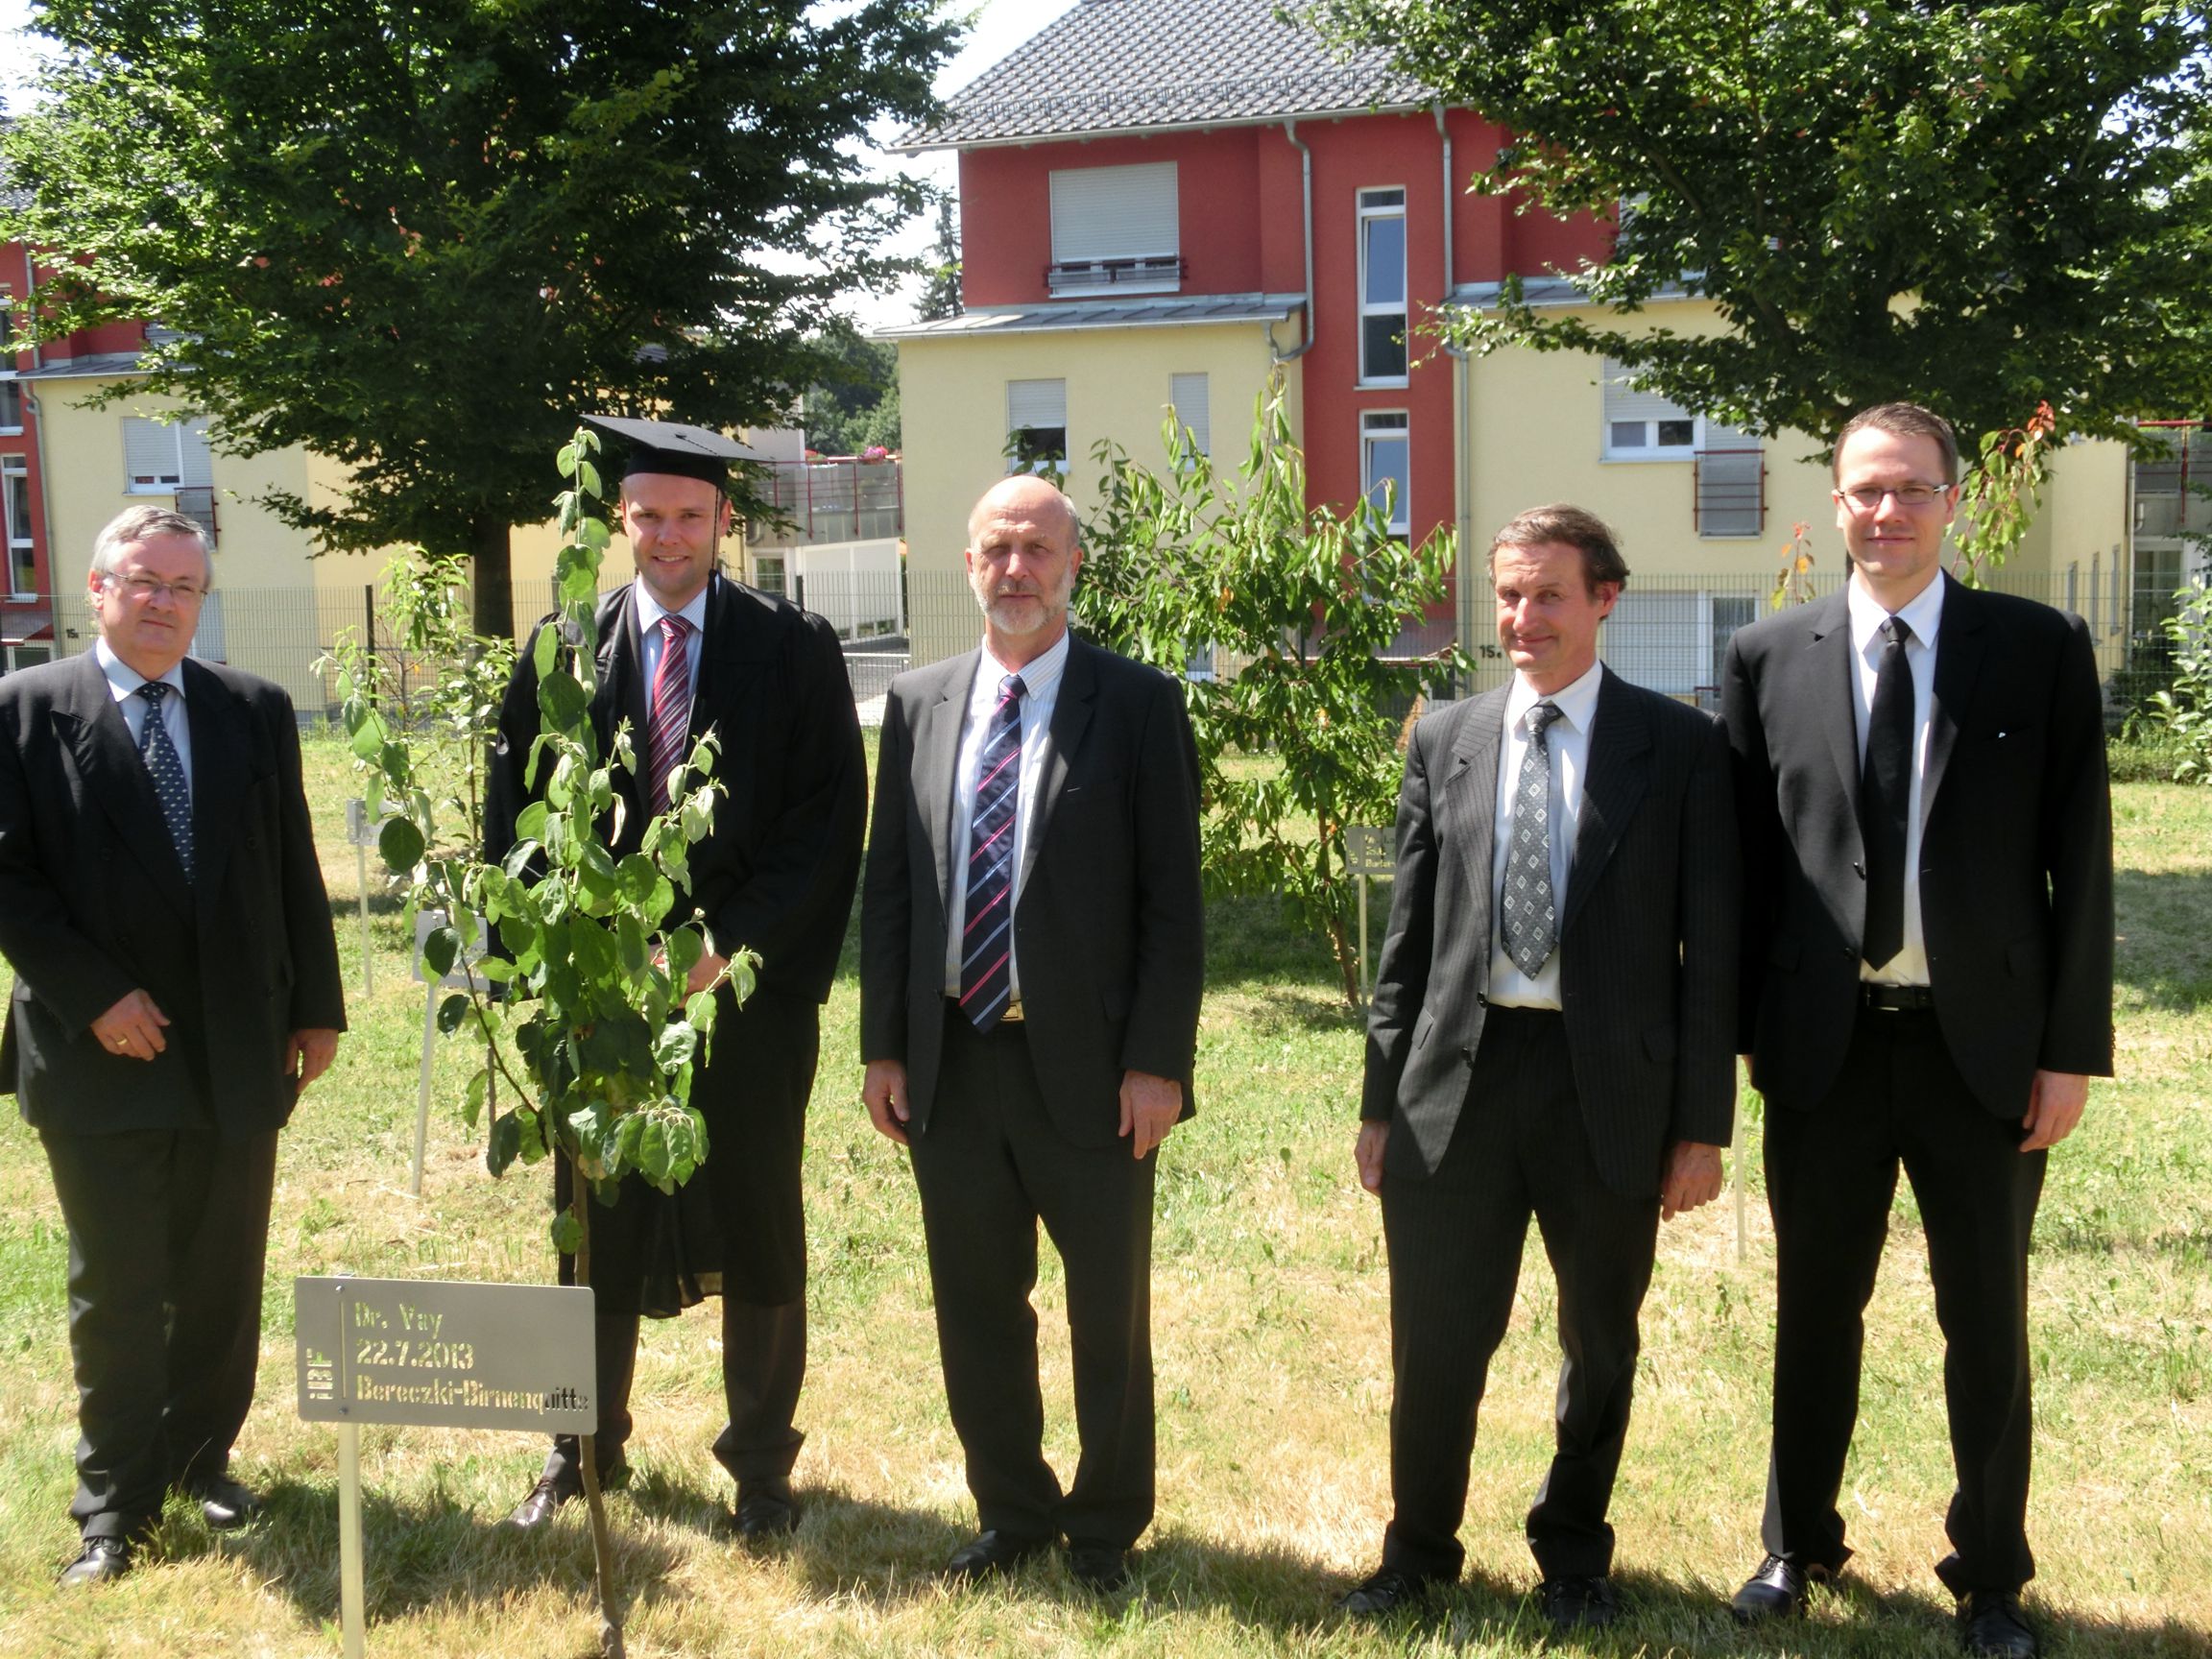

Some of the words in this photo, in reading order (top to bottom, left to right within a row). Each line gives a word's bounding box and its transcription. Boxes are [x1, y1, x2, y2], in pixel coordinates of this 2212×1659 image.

[355, 1302, 388, 1329] Dr.
[399, 1303, 444, 1339] Vay
[356, 1338, 474, 1369] 22.7.2013
